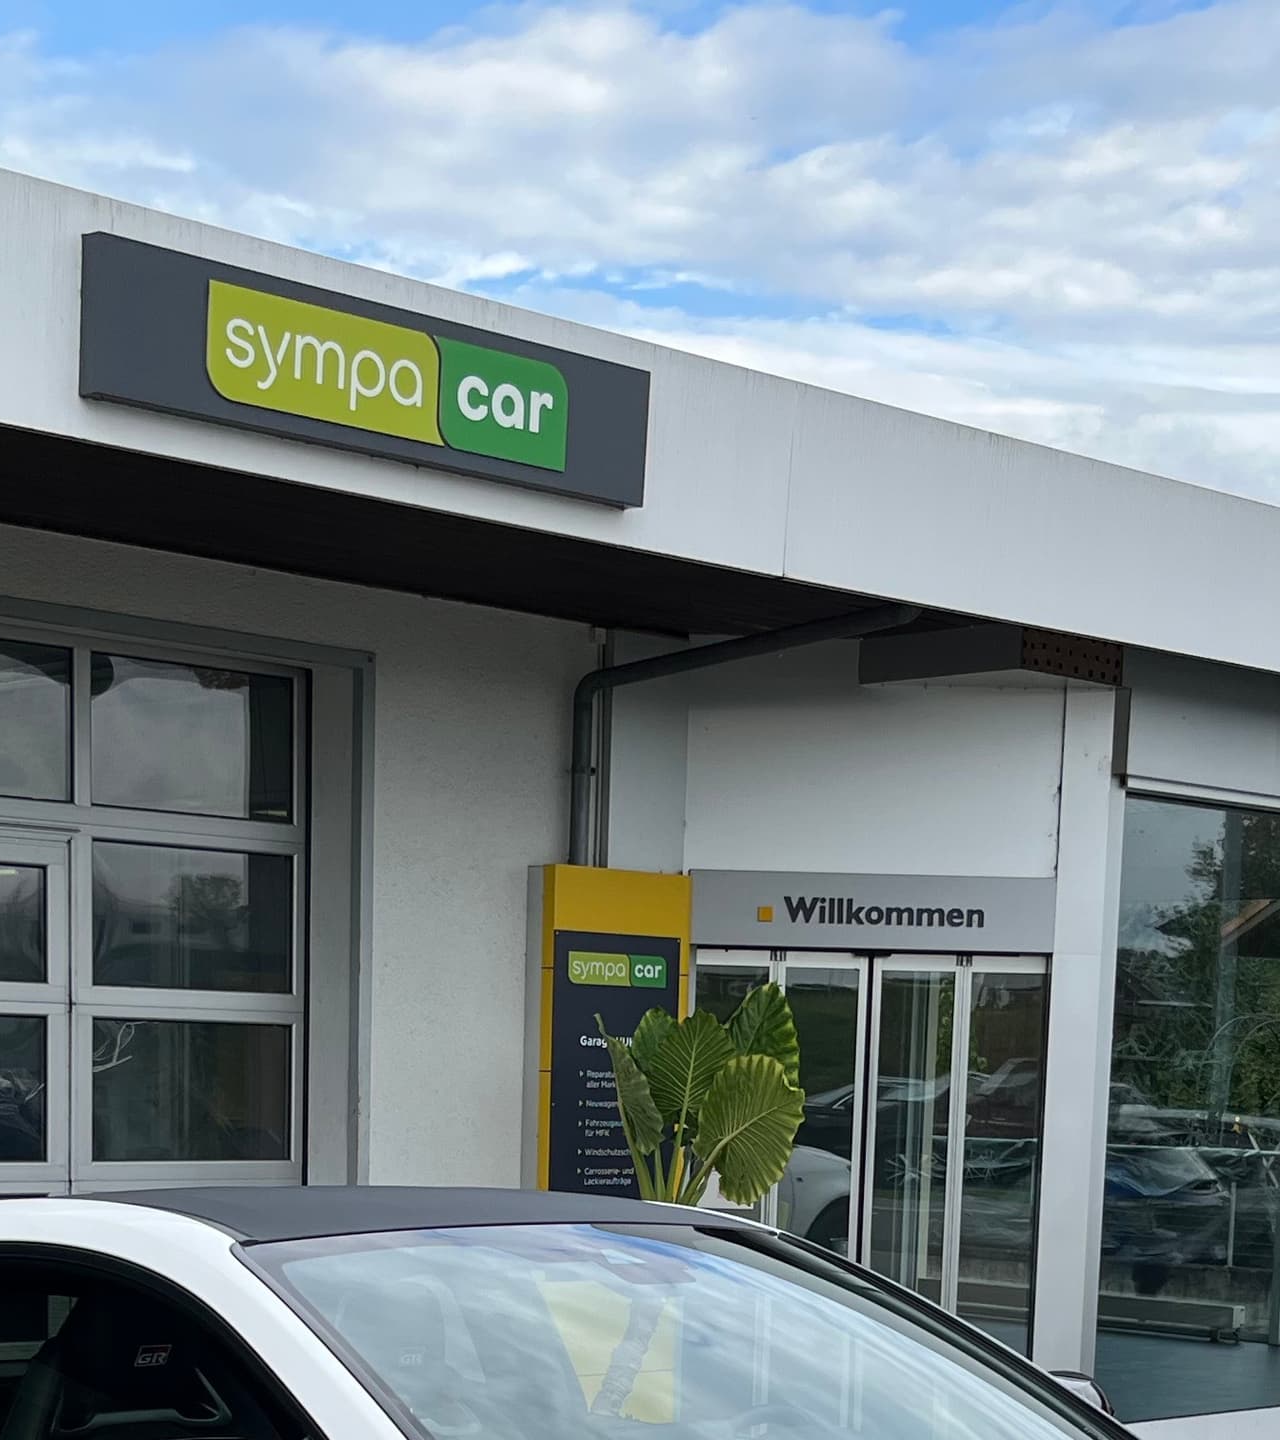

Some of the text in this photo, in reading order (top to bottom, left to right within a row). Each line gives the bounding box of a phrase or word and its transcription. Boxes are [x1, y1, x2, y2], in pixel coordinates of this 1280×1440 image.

[225, 316, 554, 434] sympa car
[784, 896, 985, 929] Willkommen
[572, 960, 663, 981] sympa car
[580, 1035, 609, 1049] Garag
[137, 1352, 168, 1366] GR
